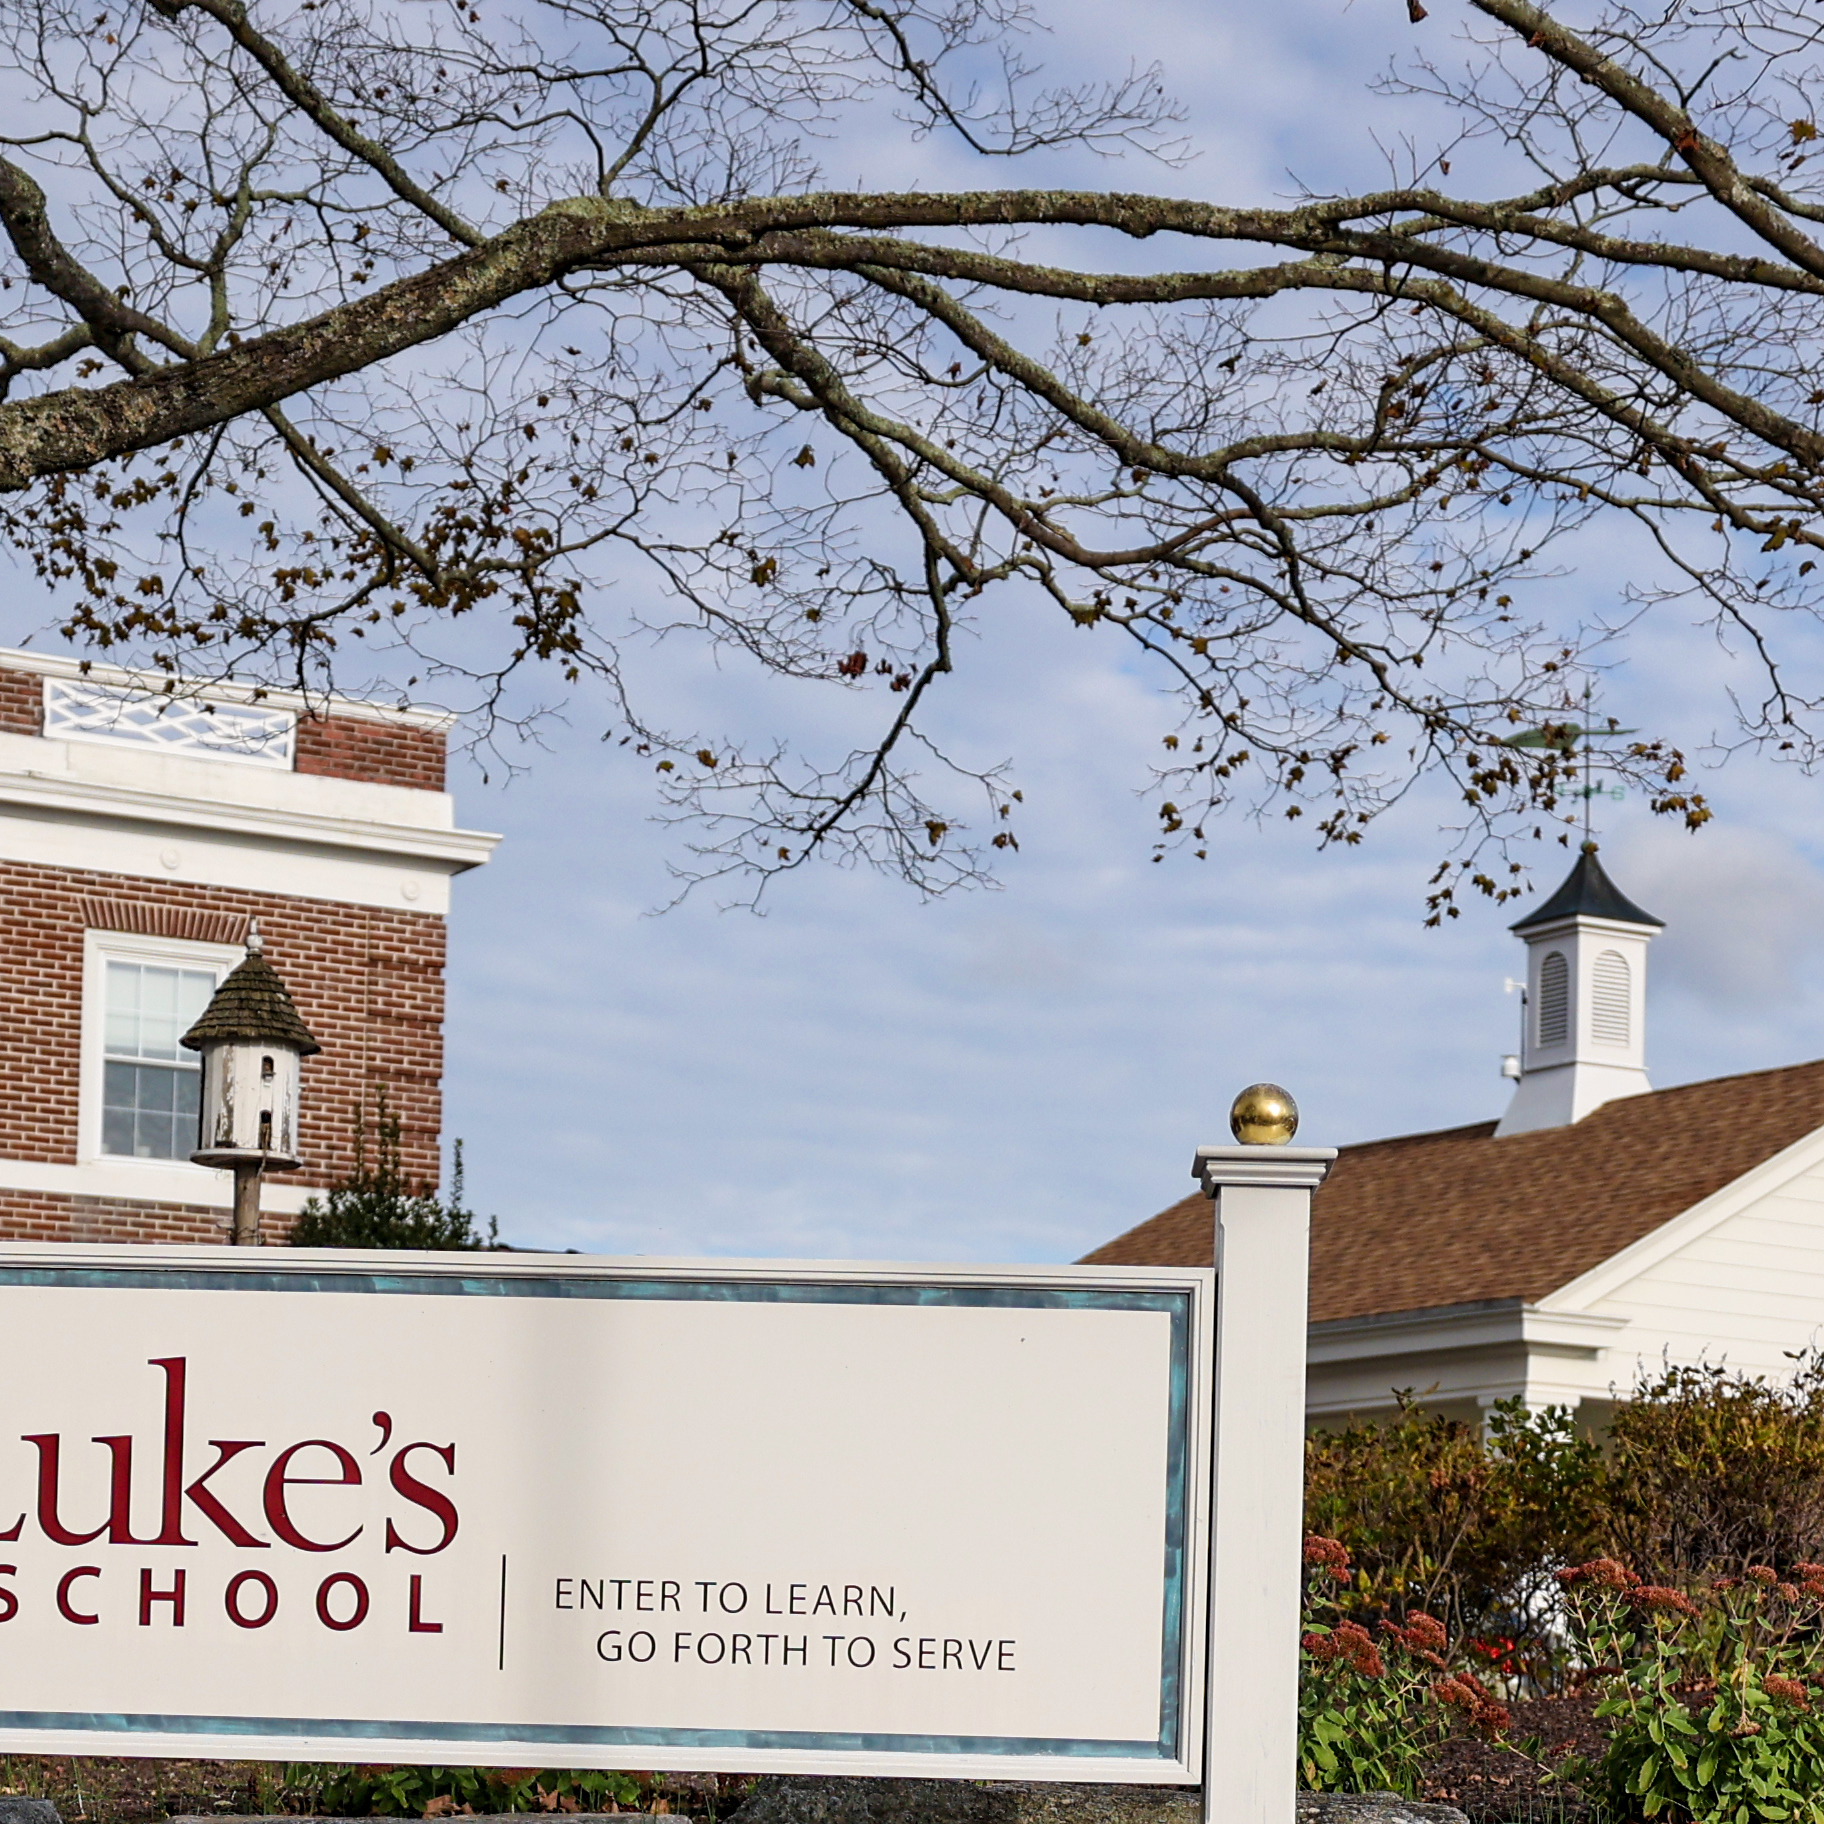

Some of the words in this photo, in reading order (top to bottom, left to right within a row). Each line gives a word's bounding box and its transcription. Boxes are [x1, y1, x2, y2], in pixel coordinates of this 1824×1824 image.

[555, 1578, 681, 1612] ENTER
[694, 1581, 748, 1614] TO
[765, 1583, 907, 1623] LEARN,
[596, 1629, 656, 1663] GO
[674, 1632, 808, 1666] FORTH
[822, 1635, 876, 1668] TO
[892, 1637, 1016, 1672] SERVE
